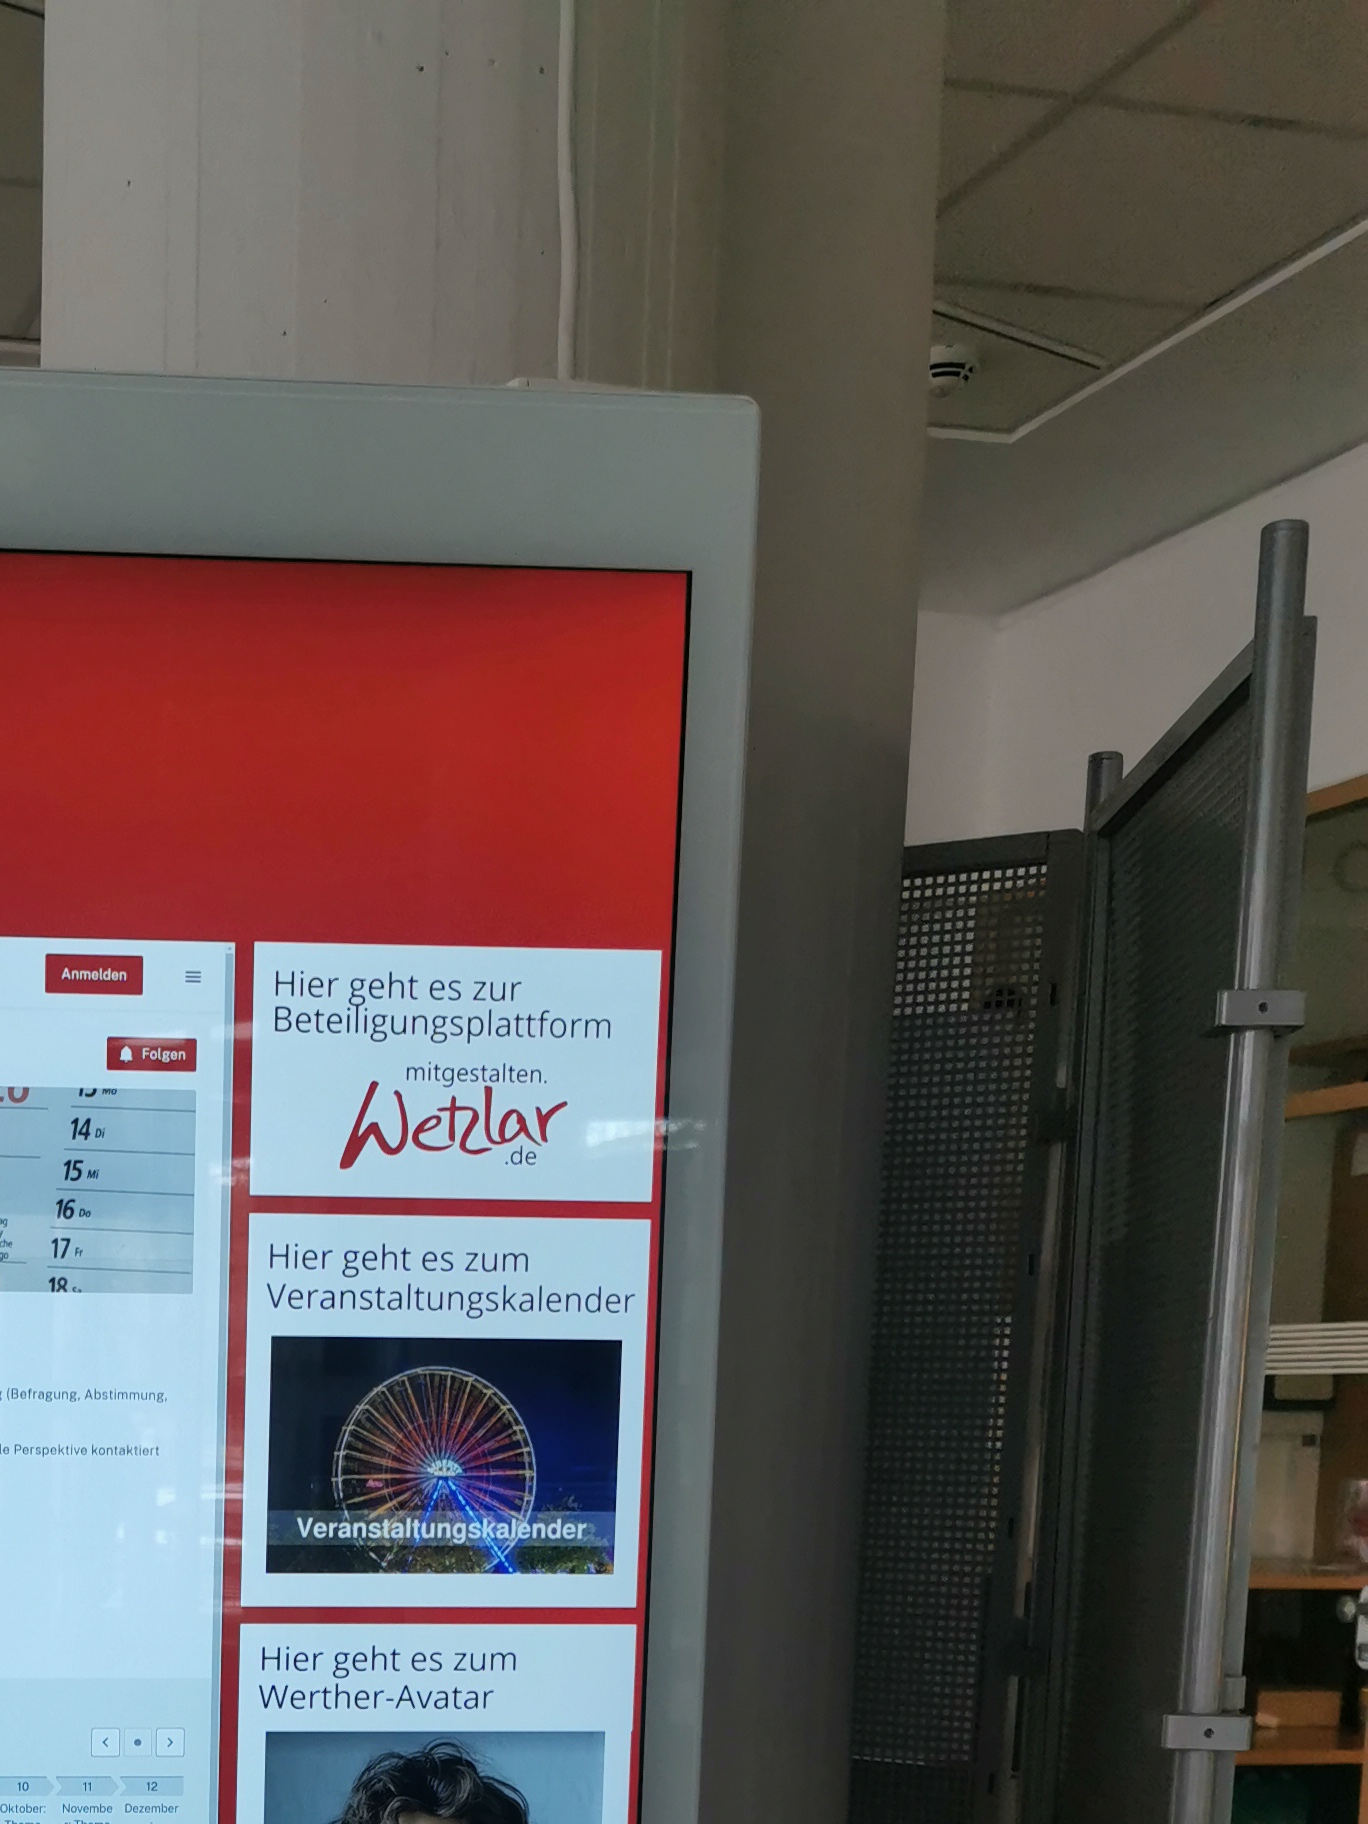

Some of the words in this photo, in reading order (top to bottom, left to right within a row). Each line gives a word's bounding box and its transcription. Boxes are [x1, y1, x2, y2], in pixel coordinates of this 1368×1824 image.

[61, 967, 128, 982] Anmelden
[274, 970, 340, 999] Hier
[348, 972, 420, 1006] geht
[429, 979, 462, 1002] es
[472, 980, 522, 1003] zur
[273, 1004, 612, 1043] Beteiligungsplattform
[141, 1047, 186, 1063] Folgen
[405, 1061, 548, 1088] mitgestalten.
[70, 1116, 92, 1141] 14
[95, 1127, 106, 1139] Di
[339, 1080, 568, 1170] Wetzlar
[504, 1145, 538, 1167] .de
[63, 1159, 84, 1182] 15
[87, 1168, 100, 1180] Mi
[55, 1198, 76, 1220] 16
[79, 1208, 92, 1218] Do
[50, 1237, 72, 1260] 17
[74, 1246, 84, 1258] Fr
[268, 1243, 333, 1271] Hier
[342, 1244, 412, 1278] geht
[421, 1250, 455, 1273] es
[464, 1251, 530, 1274] zum
[266, 1282, 636, 1319] Veranstaltungskalender
[6, 1387, 81, 1403] (Befragung,
[84, 1387, 168, 1404] Abstimmung,
[296, 1516, 587, 1545] Veranstaltungskalender
[260, 1645, 324, 1672] Hier
[333, 1645, 402, 1679] geht
[410, 1650, 443, 1672] es
[454, 1650, 518, 1672] zum
[258, 1684, 495, 1711] Werther-Avatar
[0, 1803, 47, 1814] Oktober:
[124, 1802, 180, 1814] Dezember
